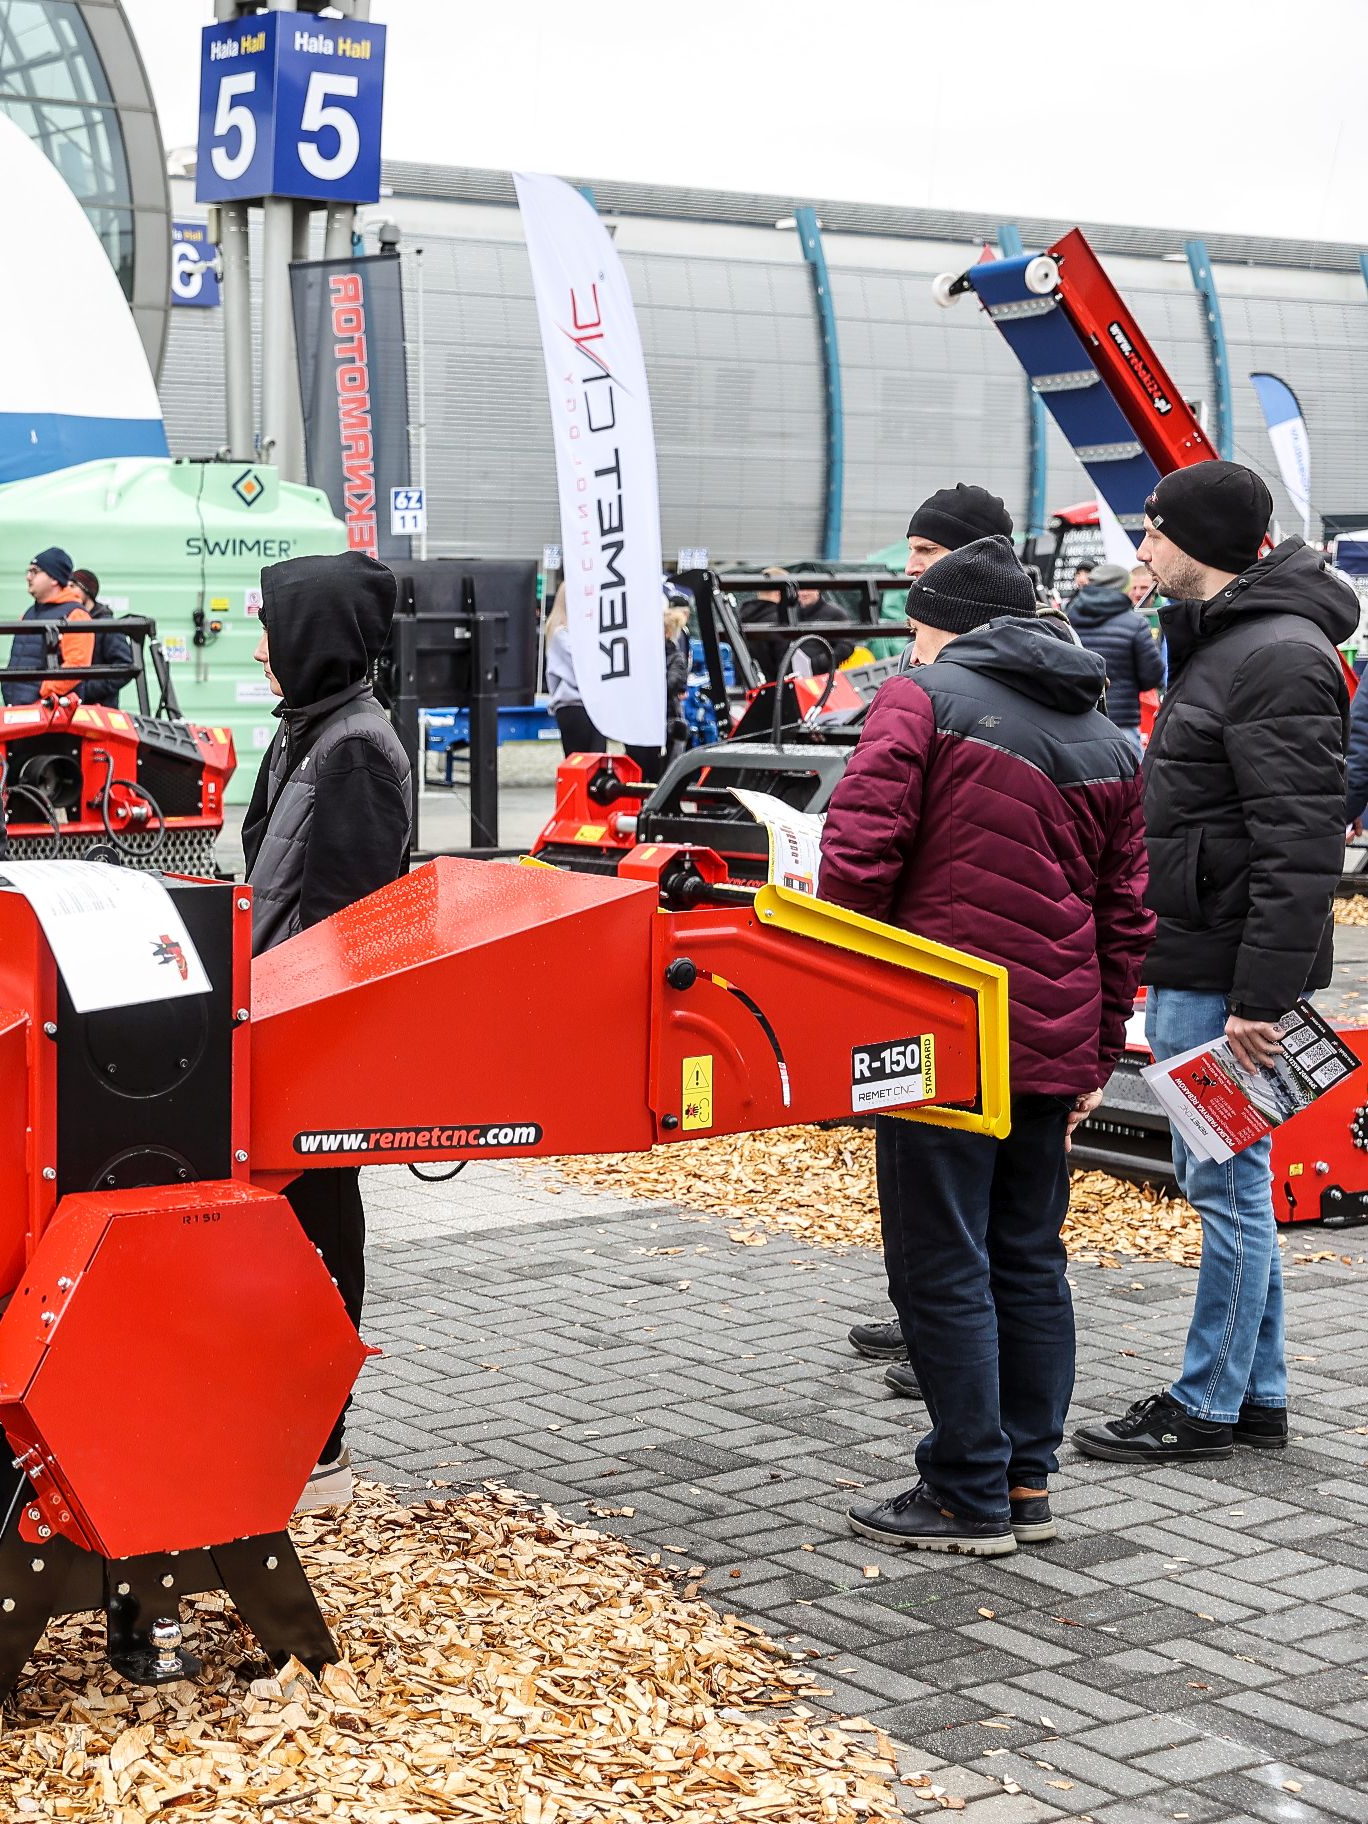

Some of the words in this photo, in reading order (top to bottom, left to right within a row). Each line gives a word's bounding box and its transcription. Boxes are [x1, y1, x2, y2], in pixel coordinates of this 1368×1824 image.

[210, 38, 239, 61] Hala
[241, 31, 266, 55] Hall
[294, 31, 334, 55] Hala
[337, 36, 371, 60] Hall
[211, 71, 257, 181] 5
[297, 71, 361, 181] 5
[172, 242, 203, 298] 6
[395, 492, 422, 510] 6Z
[399, 515, 419, 529] 11
[186, 537, 291, 558] SWIMER
[978, 715, 1002, 728] 4F
[854, 1044, 920, 1079] R-150
[924, 1038, 933, 1095] STANDARD
[858, 1088, 892, 1102] REMET
[893, 1082, 917, 1098] CNC
[1196, 1103, 1219, 1128] FABRYKA
[299, 1126, 536, 1152] www.remetcnc.com
[1216, 1126, 1235, 1147] POLSKA
